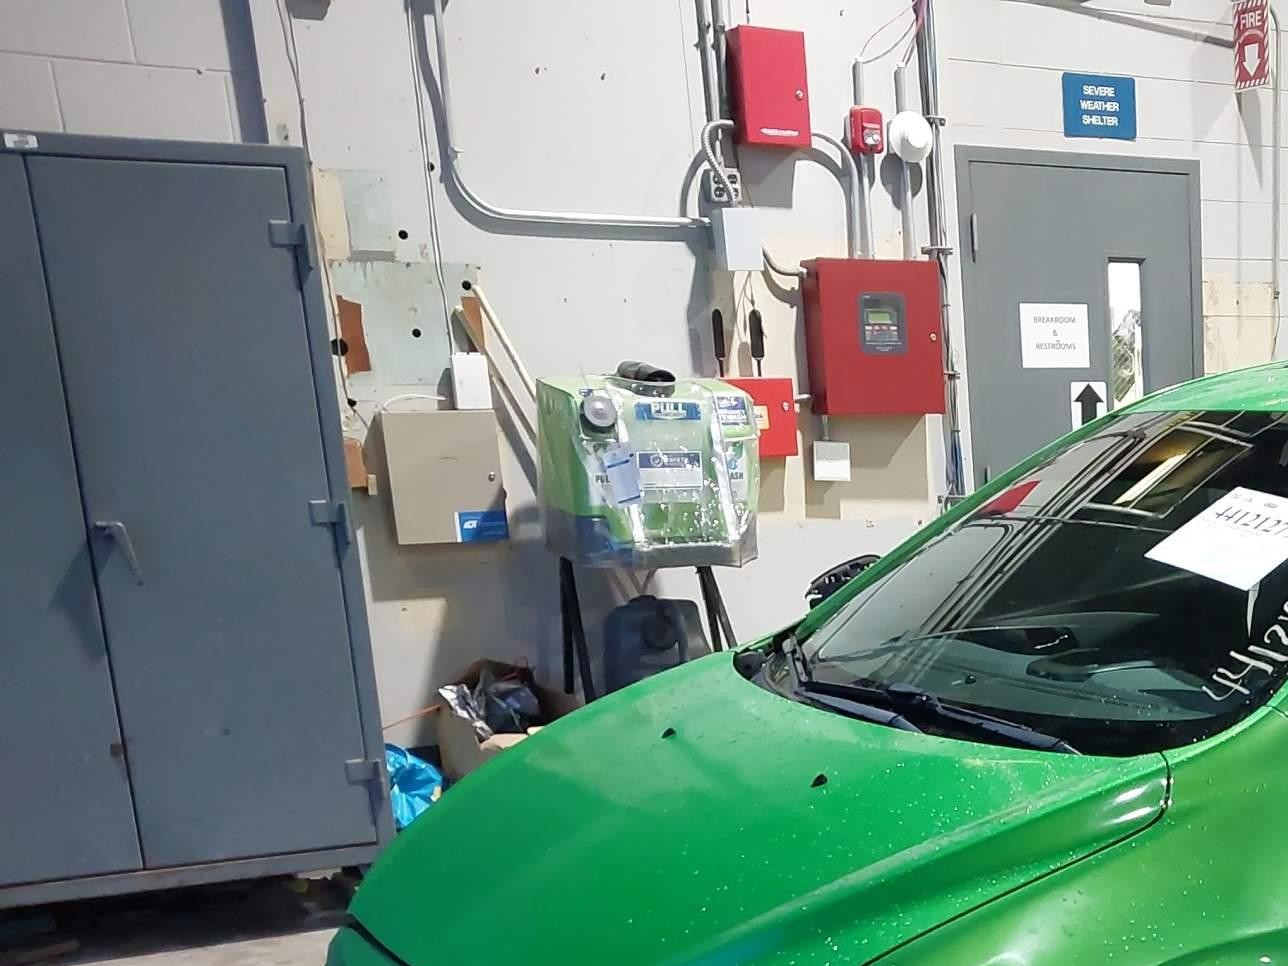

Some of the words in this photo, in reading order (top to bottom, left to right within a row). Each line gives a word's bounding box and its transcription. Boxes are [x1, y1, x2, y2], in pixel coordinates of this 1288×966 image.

[1240, 10, 1262, 30] FIRE
[1082, 85, 1116, 97] SEVERE
[1080, 99, 1120, 112] WEATHER
[1082, 114, 1119, 127] SHELTER
[1033, 316, 1076, 324] BREAKROOM
[1052, 329, 1058, 337] &
[651, 402, 687, 413] PULL
[595, 474, 611, 483] PUL
